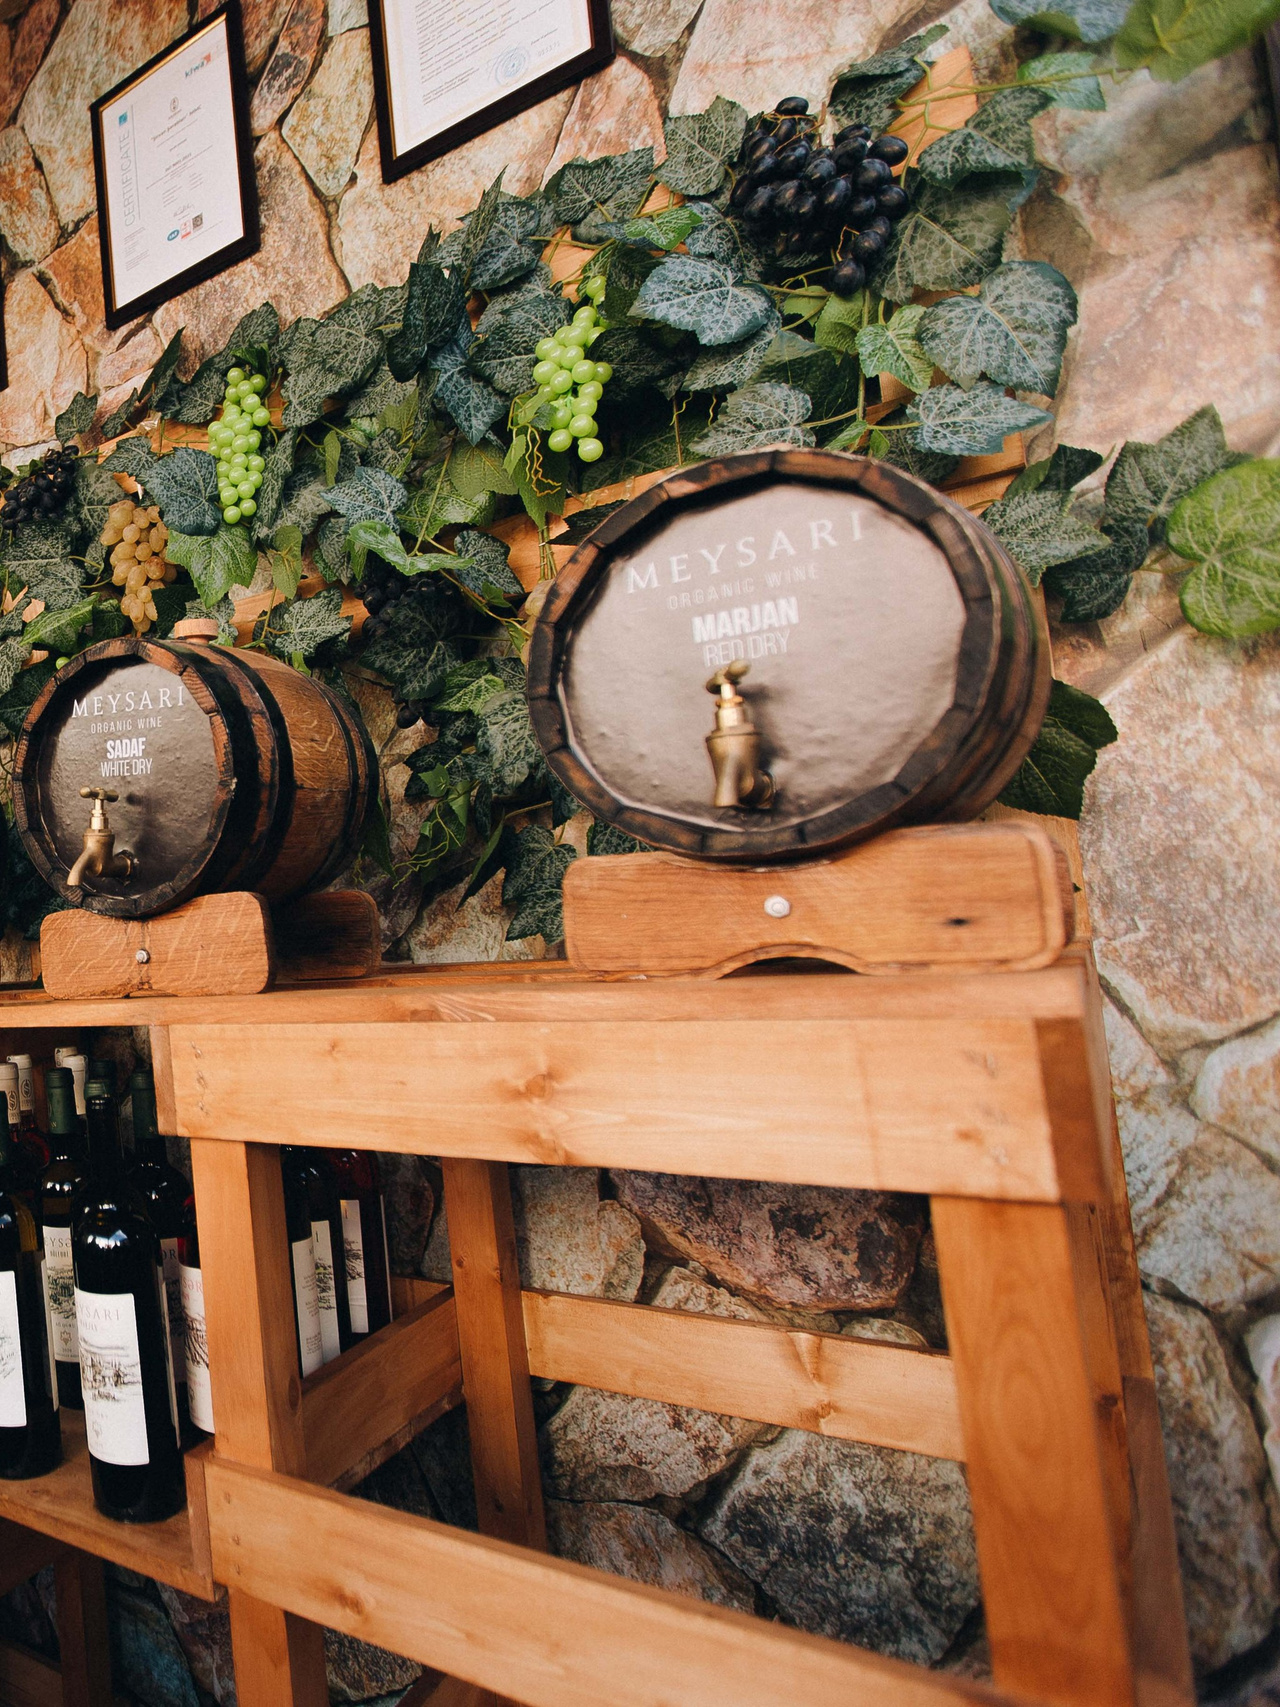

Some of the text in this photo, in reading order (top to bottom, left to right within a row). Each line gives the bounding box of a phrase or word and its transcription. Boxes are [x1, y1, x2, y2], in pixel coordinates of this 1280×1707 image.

[185, 61, 204, 79] kiwa
[119, 130, 137, 227] CERTIFICATE
[627, 510, 864, 594] MEYSARI
[668, 563, 820, 610] ORGANIC WINE
[692, 596, 799, 643] MARJAN
[703, 629, 790, 667] RED DRY
[72, 685, 186, 718] MEYSARI
[90, 716, 162, 734] ORGANIC WINE
[106, 737, 146, 759] SADAF
[100, 758, 153, 777] WHITE DRY
